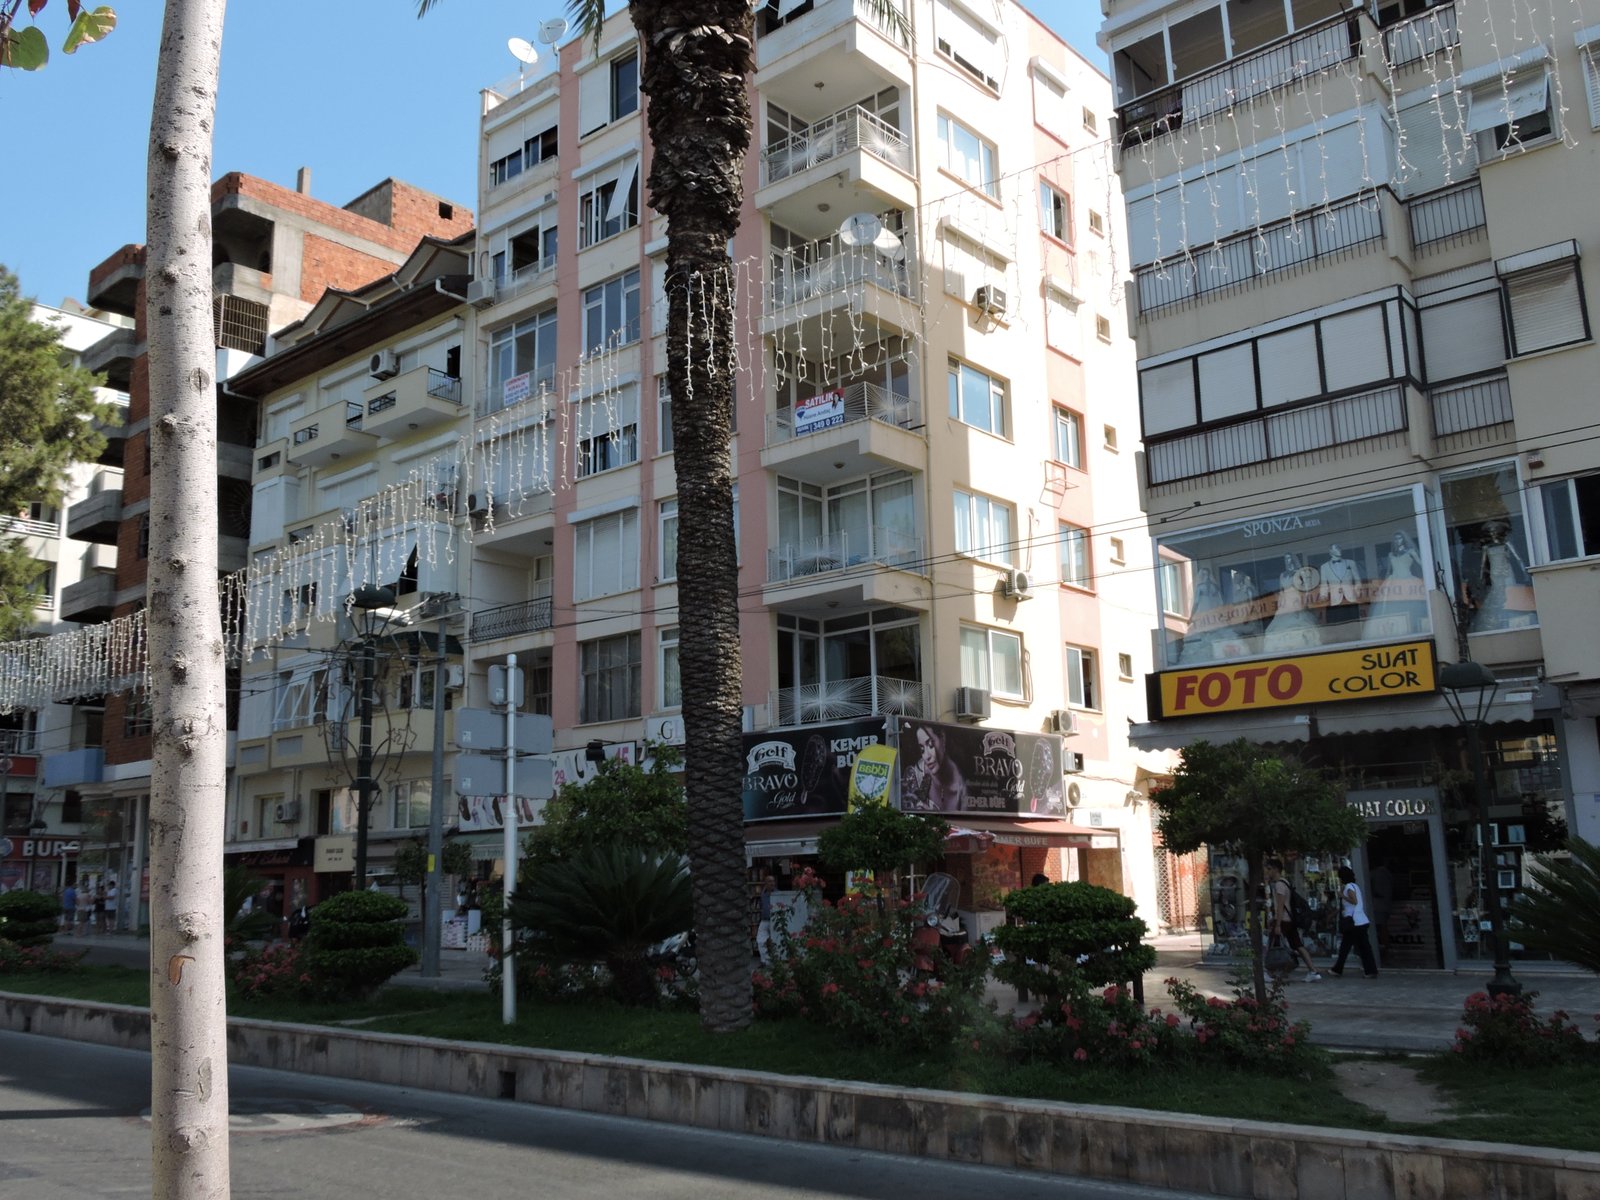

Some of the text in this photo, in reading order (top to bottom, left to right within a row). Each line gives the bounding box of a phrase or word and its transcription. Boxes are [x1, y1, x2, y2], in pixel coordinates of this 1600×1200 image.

[805, 391, 834, 408] SATILIK
[1243, 516, 1304, 538] SPONZA
[1361, 648, 1419, 671] SUAT
[1174, 663, 1303, 711] FOTO
[1328, 671, 1422, 694] COLOR
[754, 745, 788, 762] Golf
[830, 735, 879, 753] KEMER
[973, 755, 1023, 778] BRAVO
[742, 772, 798, 793] BRAVO
[1002, 777, 1026, 798] Gold
[766, 791, 797, 808] Gold
